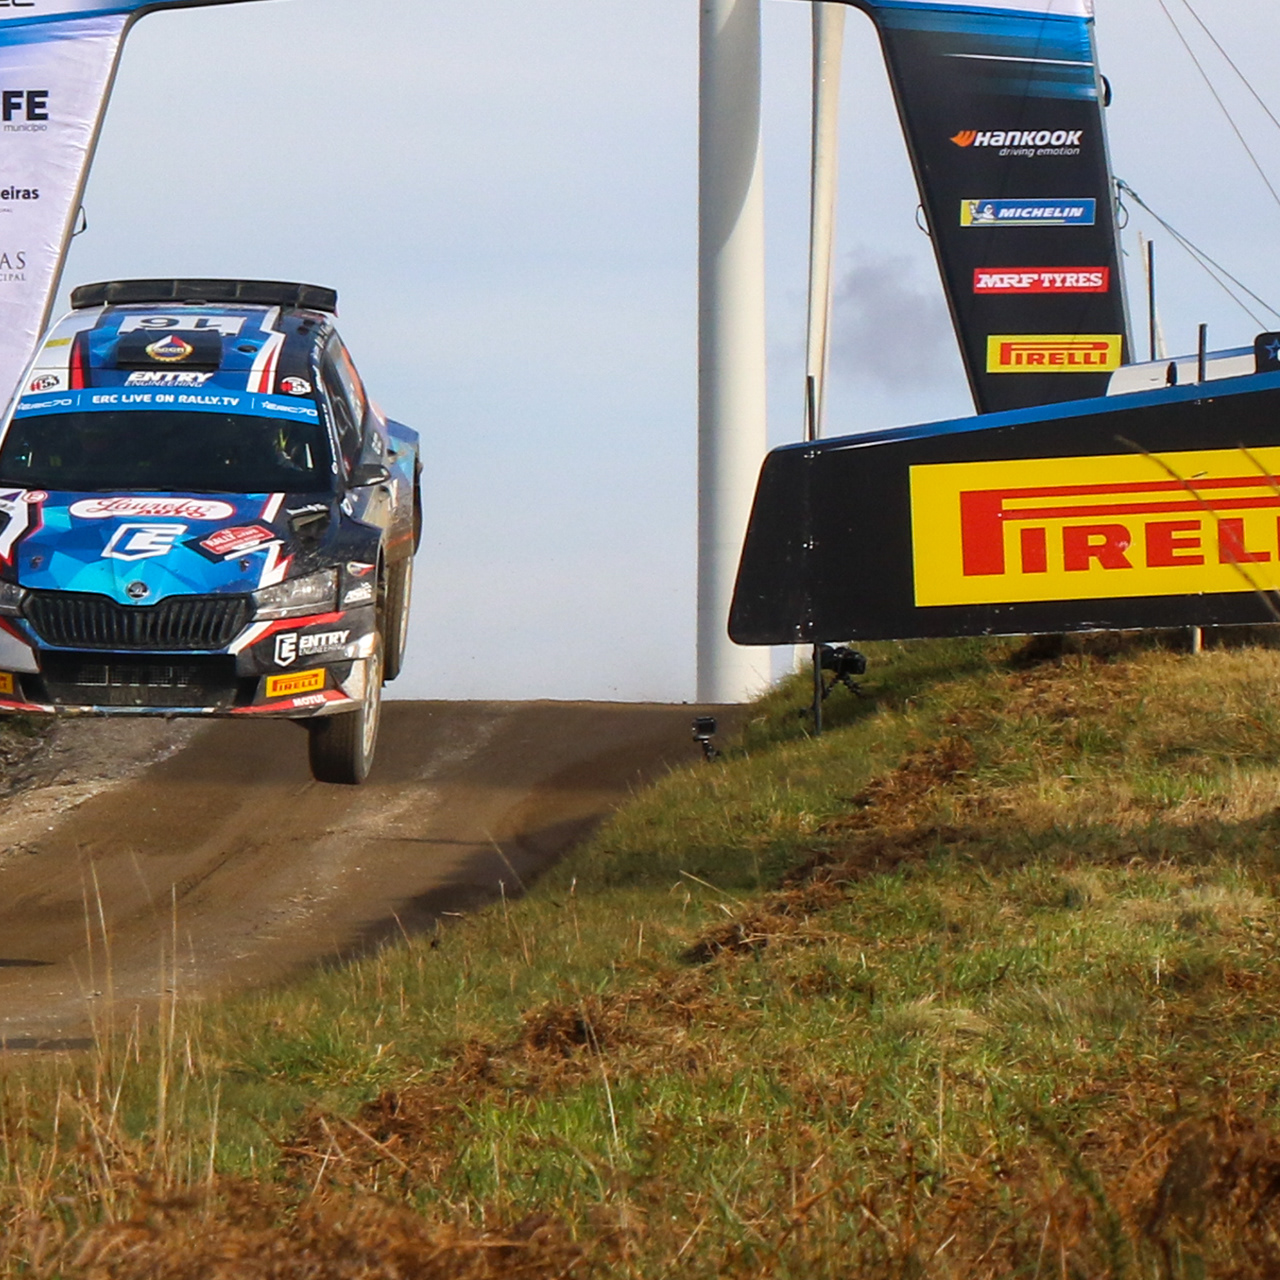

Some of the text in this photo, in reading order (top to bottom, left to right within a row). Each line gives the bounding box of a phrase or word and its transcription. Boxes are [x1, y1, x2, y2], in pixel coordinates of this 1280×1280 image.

[998, 146, 1080, 158] driving emotion
[997, 205, 1085, 219] MICHELIN
[976, 272, 1103, 289] MRF TYRES
[1000, 341, 1110, 366] PIRELLI
[129, 370, 214, 383] ENTRY
[92, 394, 240, 407] ERC LIVE ON RALLY.TV
[959, 474, 1280, 577] PIREL
[299, 630, 350, 649] ENTRY
[272, 673, 319, 692] PIRELLI
[292, 694, 327, 707] MOTUL
